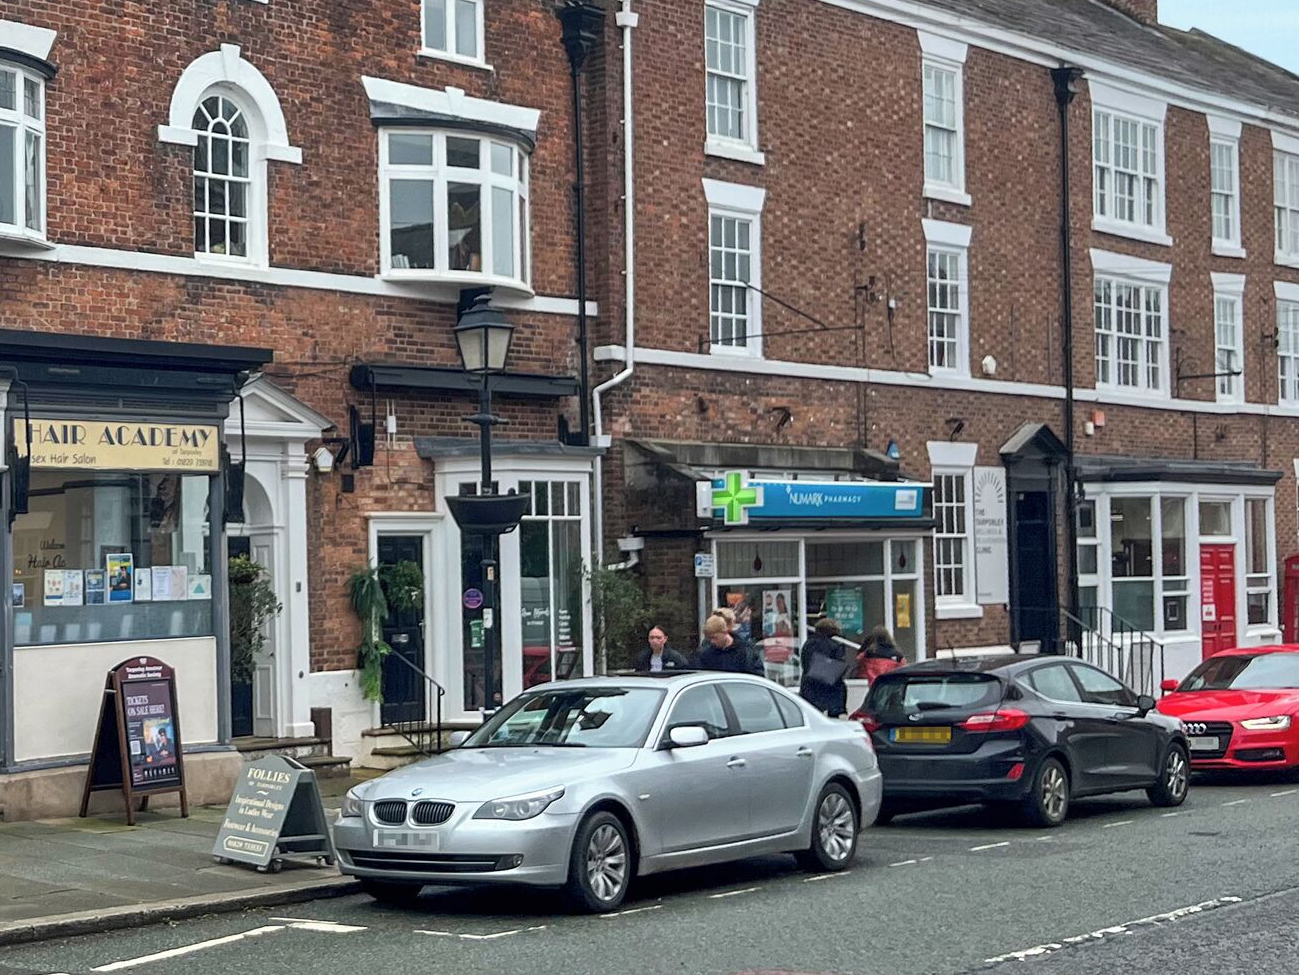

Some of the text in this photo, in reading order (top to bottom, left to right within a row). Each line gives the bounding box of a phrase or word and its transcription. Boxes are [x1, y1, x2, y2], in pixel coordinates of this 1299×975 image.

[29, 424, 212, 448] HAIR ACADEMY
[50, 453, 69, 464] Hair
[72, 453, 96, 464] Salon
[789, 492, 861, 506] NUMARK PHARMACY
[126, 695, 149, 706] TICKETS
[247, 768, 291, 783] FOLLIES
